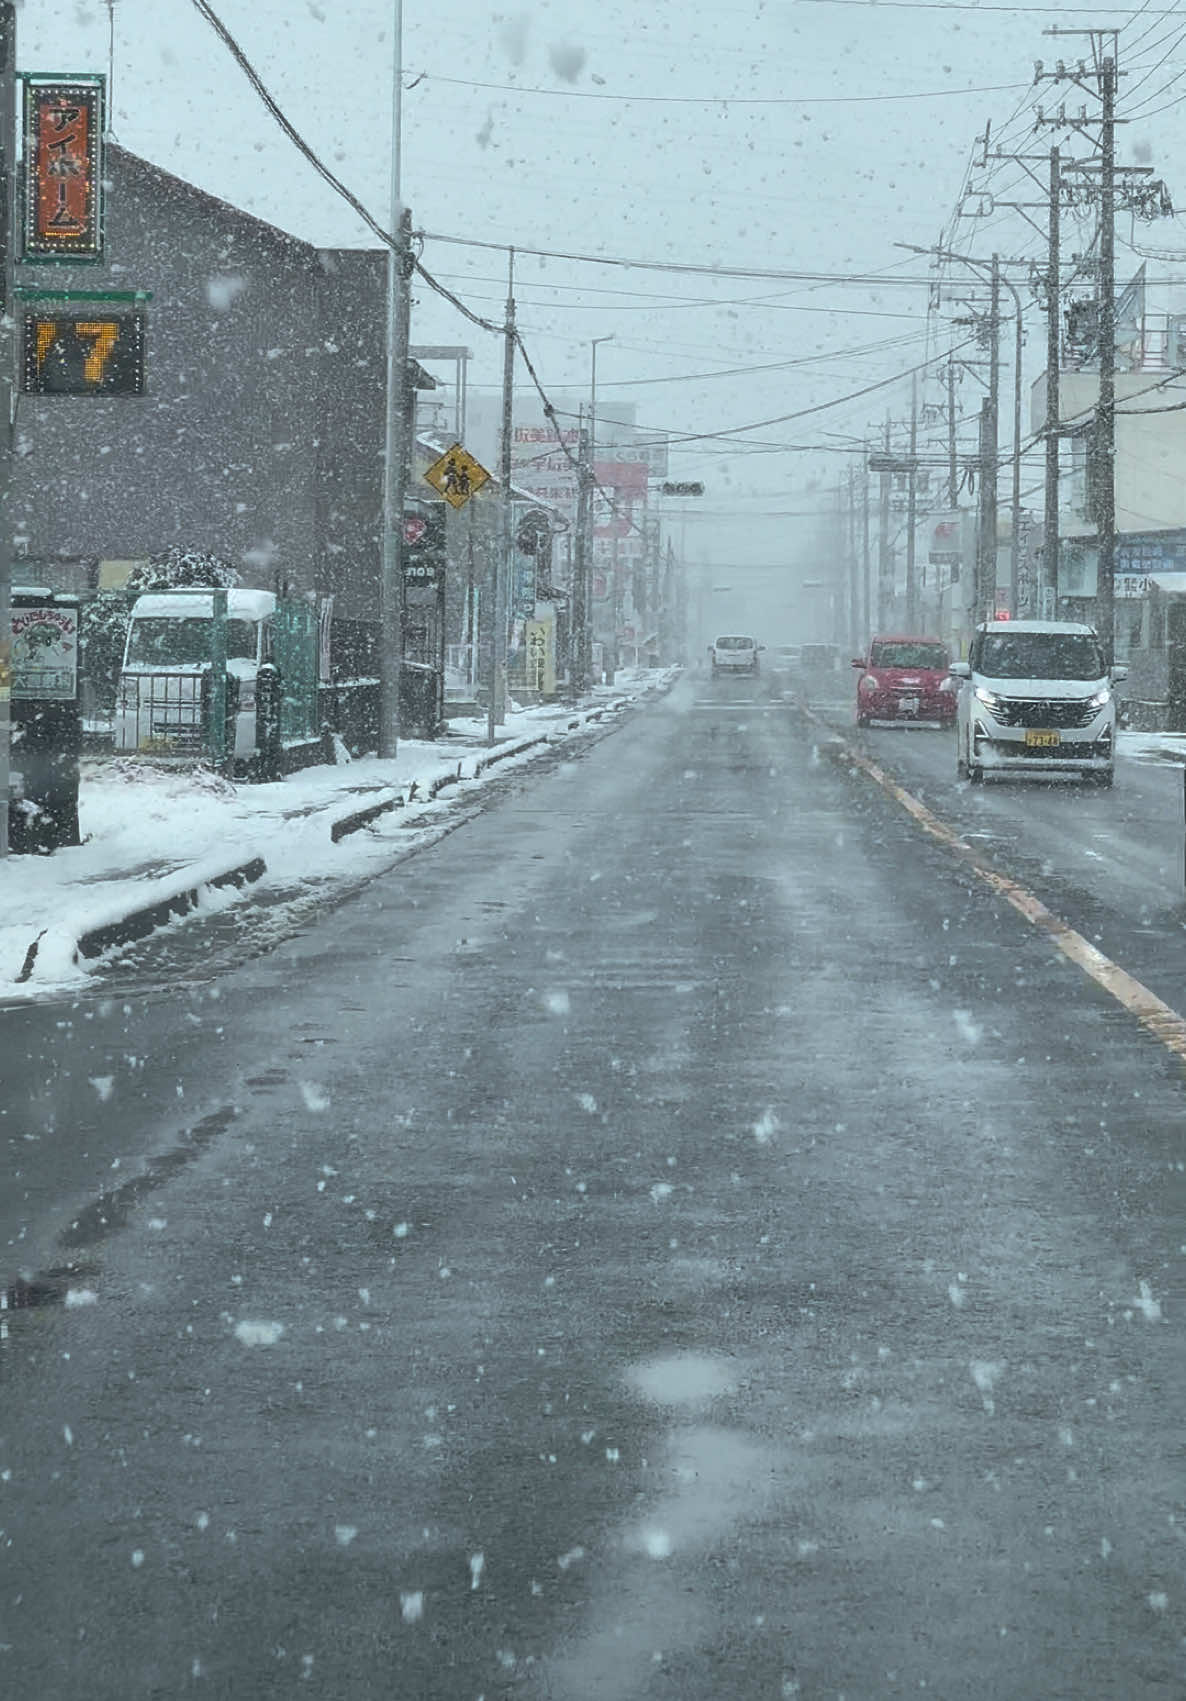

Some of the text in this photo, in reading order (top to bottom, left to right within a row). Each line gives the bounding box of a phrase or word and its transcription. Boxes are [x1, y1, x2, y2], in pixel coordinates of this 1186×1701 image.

[48, 108, 81, 227] アイホーム
